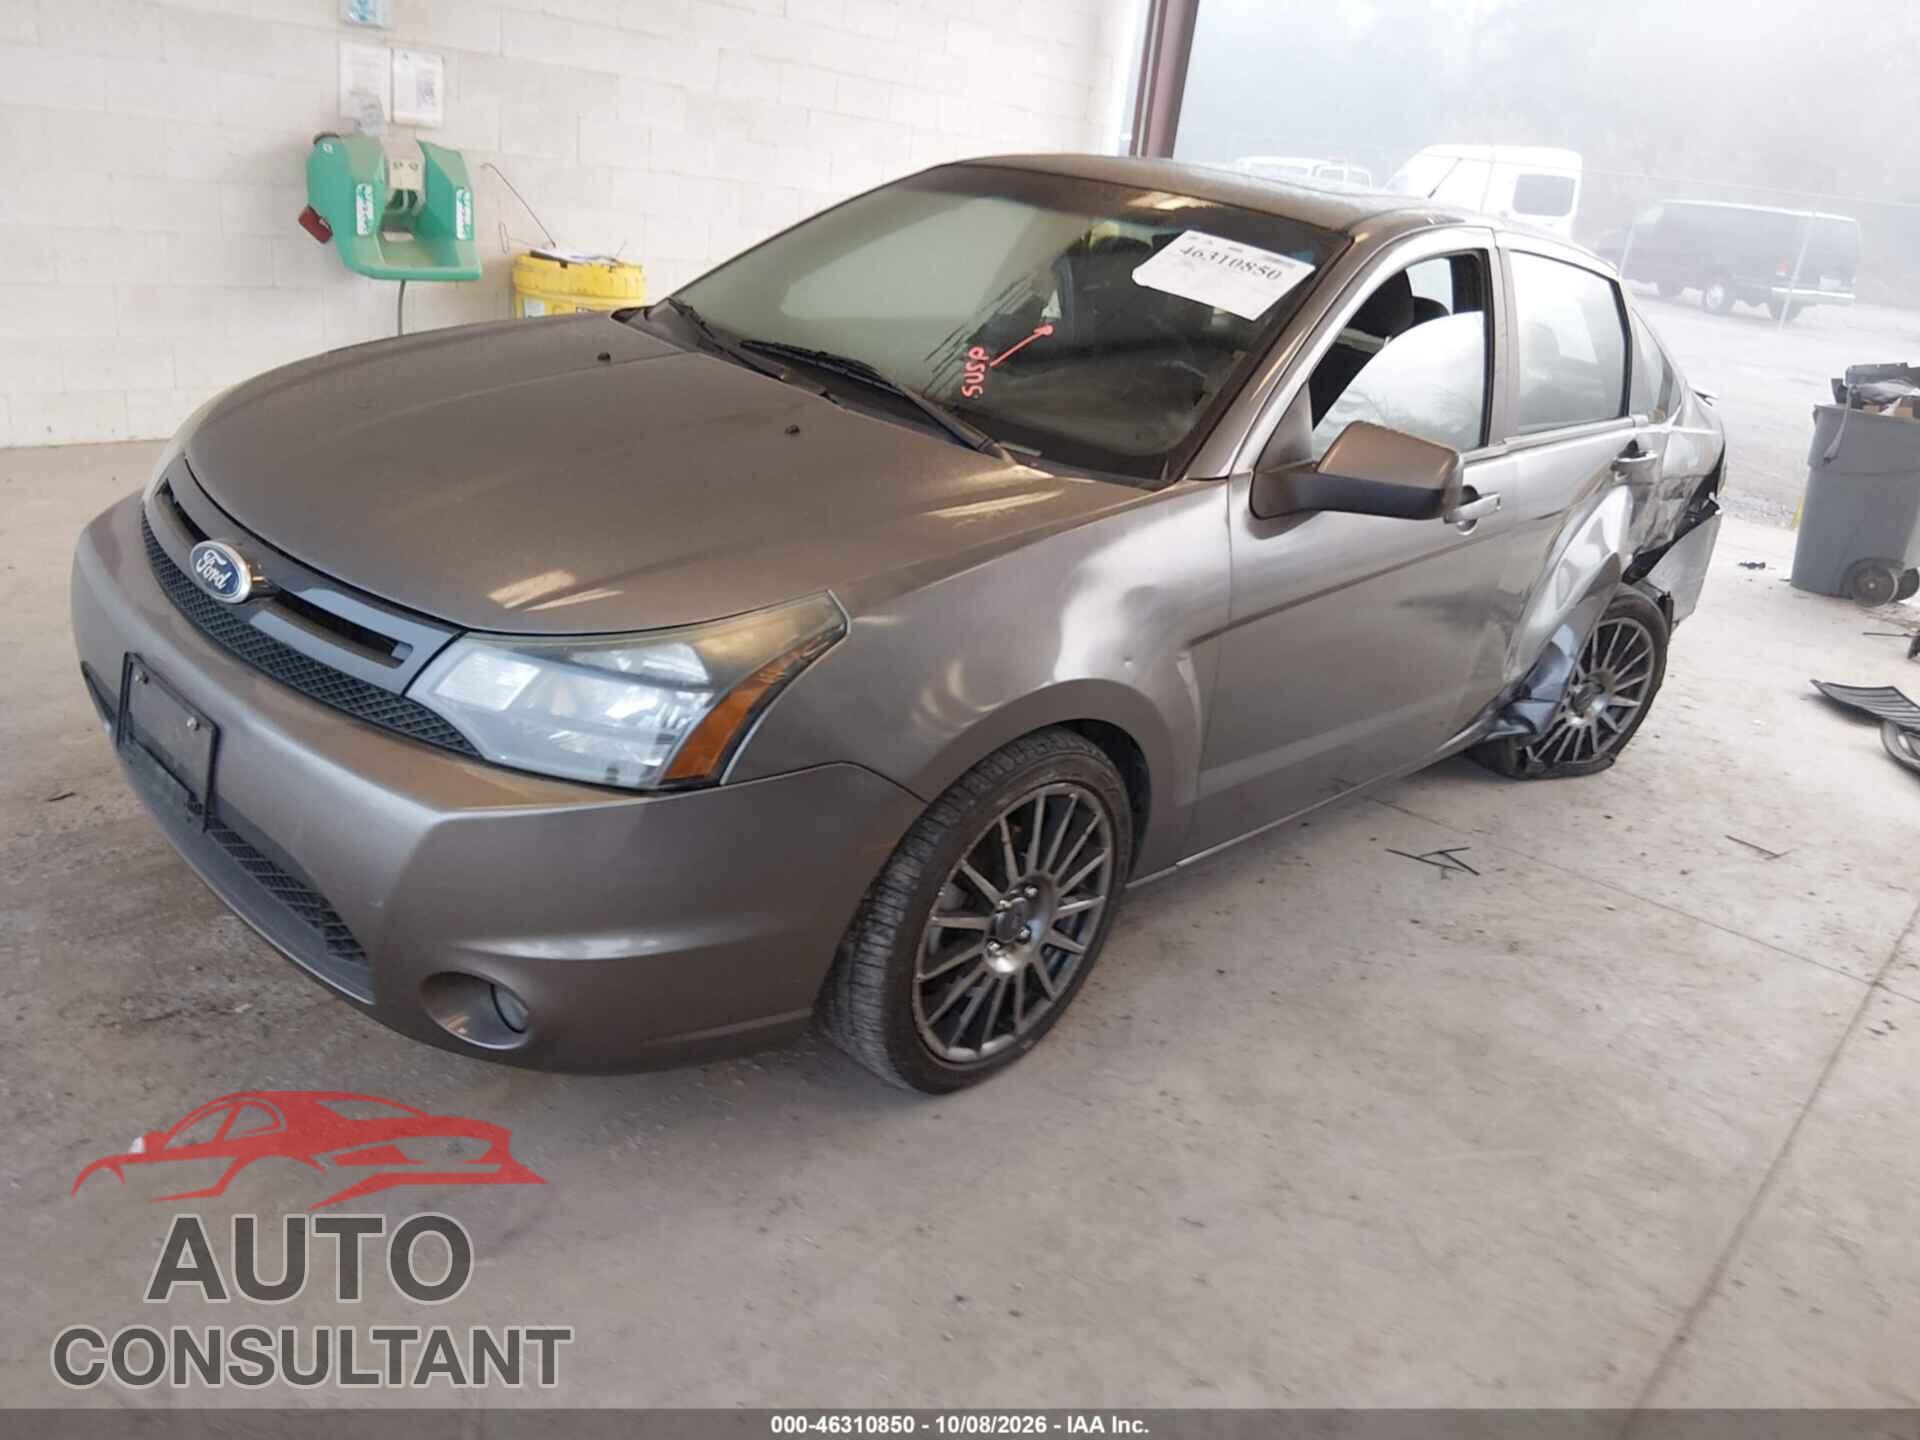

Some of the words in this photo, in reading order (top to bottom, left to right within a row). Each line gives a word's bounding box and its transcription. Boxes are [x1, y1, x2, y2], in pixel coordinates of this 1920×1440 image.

[1180, 245, 1283, 281] 46310850
[961, 346, 990, 398] SUSP
[196, 549, 232, 590] Ford
